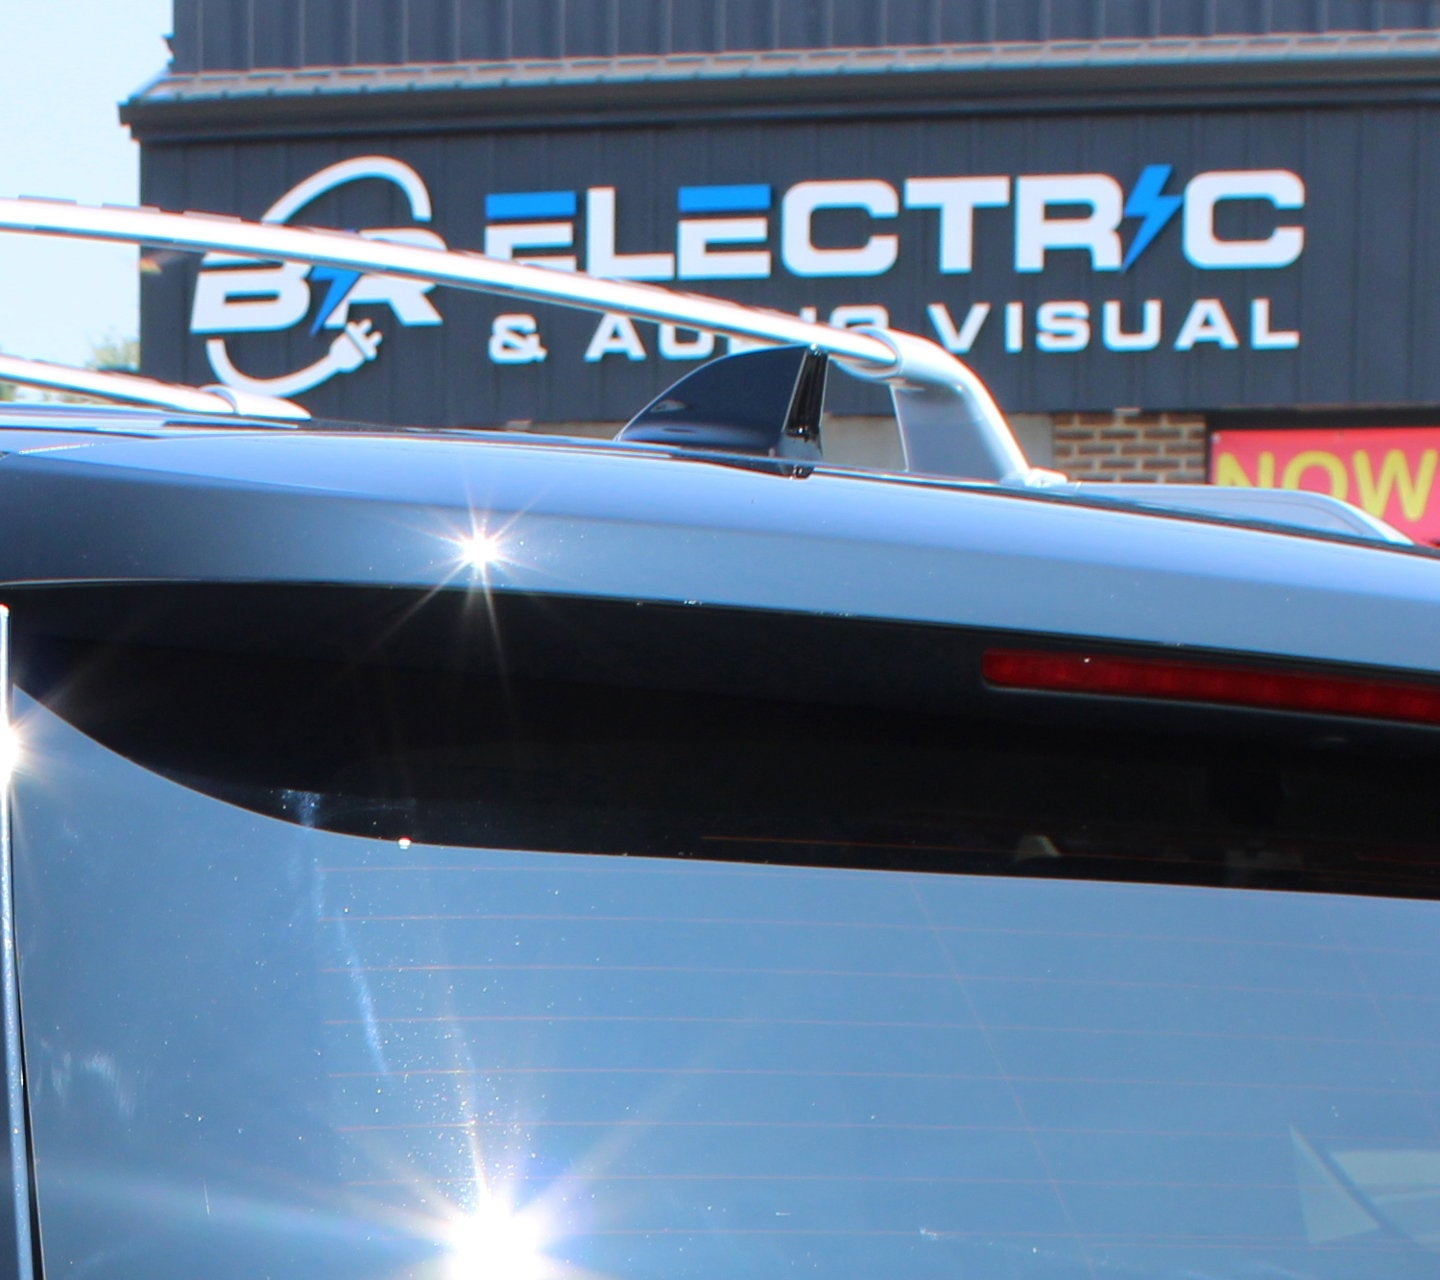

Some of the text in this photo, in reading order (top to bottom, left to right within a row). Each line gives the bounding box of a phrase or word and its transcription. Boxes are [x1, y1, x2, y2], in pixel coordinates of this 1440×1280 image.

[484, 164, 1306, 281] ELECTRIC
[488, 312, 547, 365] &
[926, 297, 1301, 355] VISUAL
